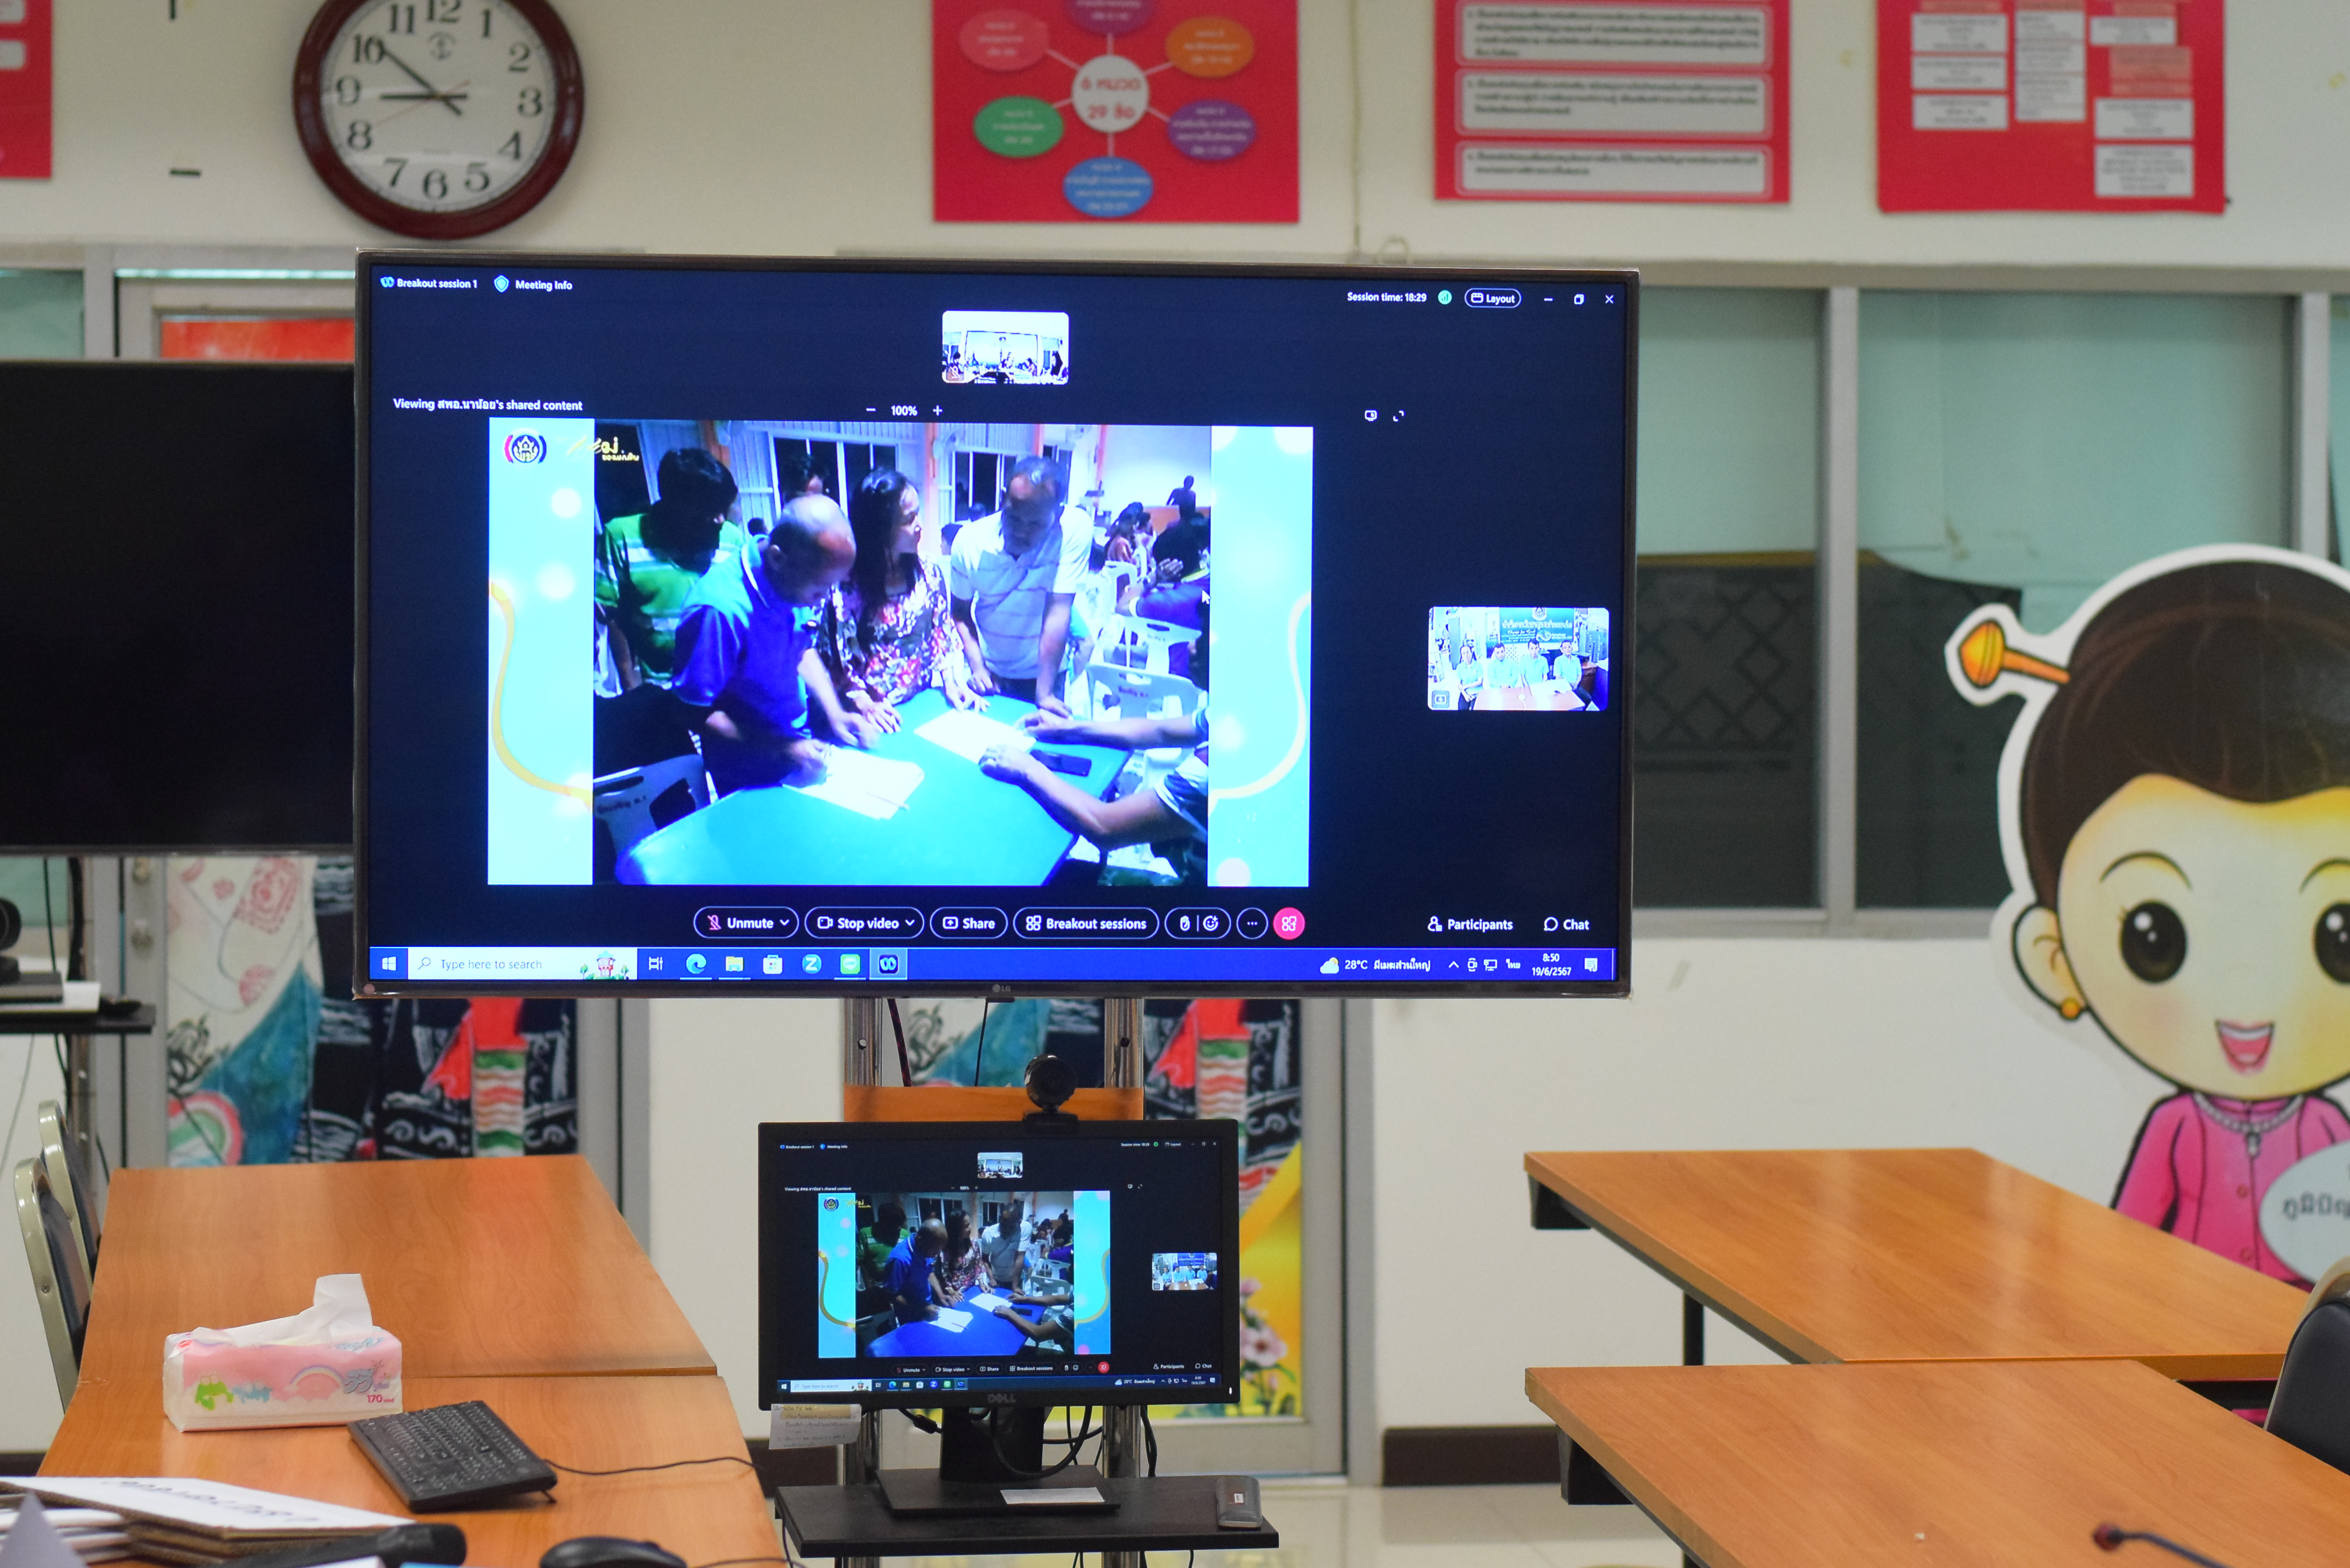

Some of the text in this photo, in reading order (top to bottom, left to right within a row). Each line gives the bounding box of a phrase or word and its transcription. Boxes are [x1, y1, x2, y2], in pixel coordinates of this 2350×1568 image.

[427, 0, 460, 24] 12
[389, 4, 415, 34] 11
[481, 9, 491, 38] 1
[354, 34, 385, 64] 10
[508, 42, 531, 72] 2
[336, 75, 361, 106] 9
[517, 87, 543, 117] 3
[348, 120, 372, 151] 8
[499, 131, 521, 160] 4
[383, 158, 408, 188] 7
[465, 163, 490, 192] 5
[423, 169, 448, 200] 6
[397, 279, 477, 289] Breakout session 1
[515, 280, 573, 292] Meeting Info
[1347, 292, 1427, 303] Session time: 18:29
[1486, 294, 1515, 306] Layout
[393, 398, 435, 411] Viewing
[506, 400, 541, 410] shared
[543, 401, 583, 411] content
[891, 405, 918, 416] 100%
[727, 918, 774, 929] Unmute
[837, 918, 899, 931] Stop video
[962, 918, 996, 929] Share
[1046, 918, 1147, 930] Breakout sessions
[1447, 919, 1514, 932] Participants
[1563, 919, 1590, 930] Chat
[1506, 958, 1521, 969] ไทย
[1542, 953, 1560, 963] 8:50
[441, 959, 542, 972] Type here to search
[1531, 966, 1572, 977] 19/6/2567
[367, 1394, 383, 1403] 170
[988, 1393, 1016, 1403] DELL
